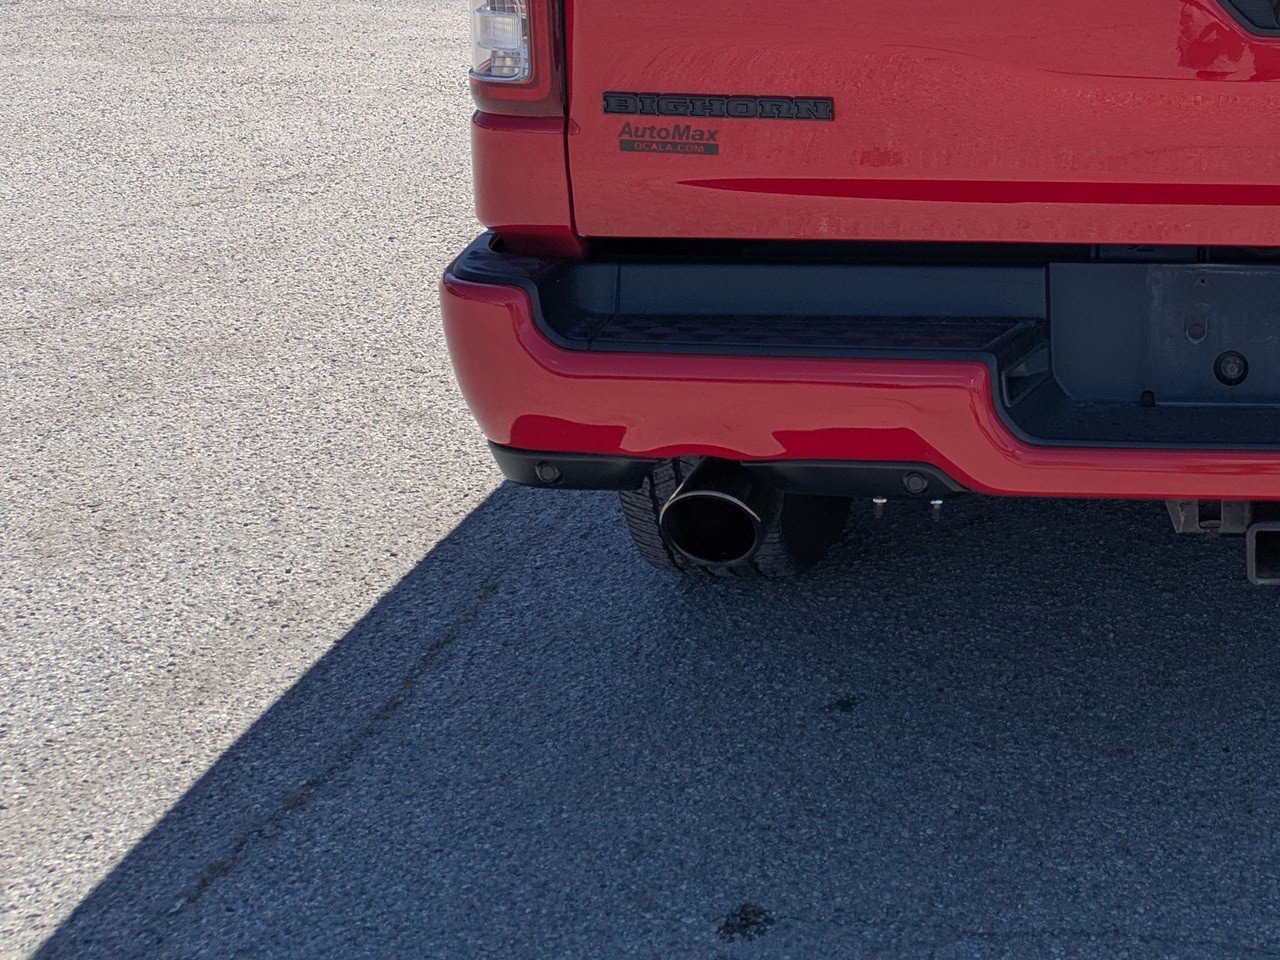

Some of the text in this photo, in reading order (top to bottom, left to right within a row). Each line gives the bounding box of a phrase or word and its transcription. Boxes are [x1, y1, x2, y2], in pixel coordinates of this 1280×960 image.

[602, 91, 835, 122] BIGHORN
[618, 121, 720, 142] AutoMax
[633, 141, 705, 153] OCALA.COM
